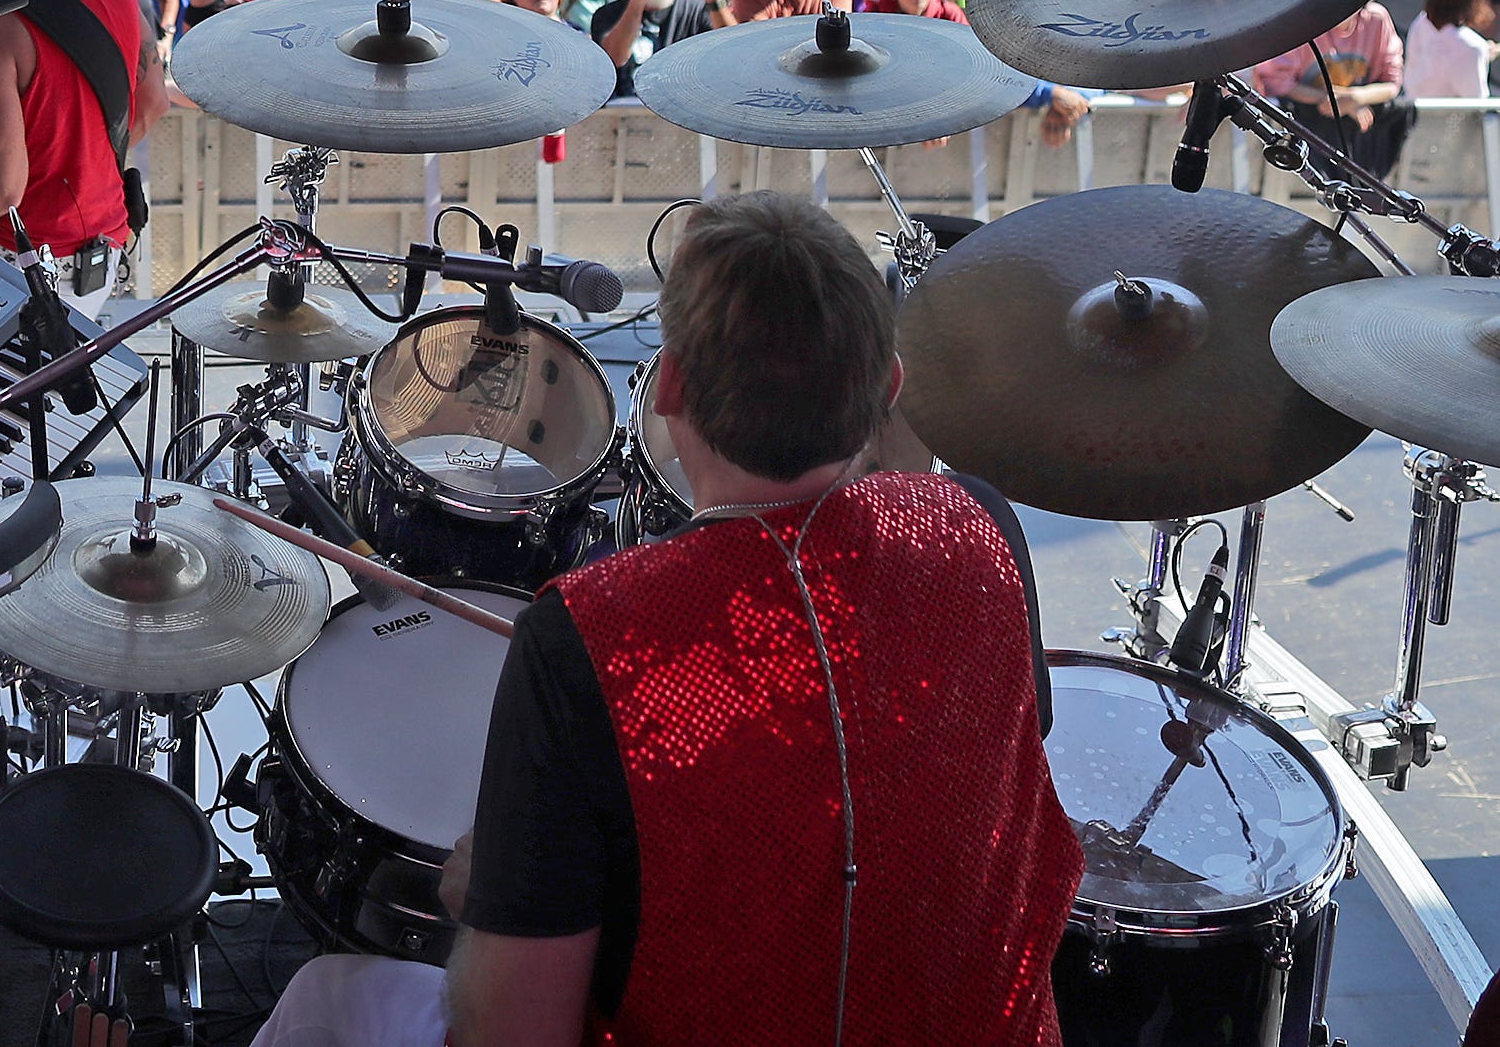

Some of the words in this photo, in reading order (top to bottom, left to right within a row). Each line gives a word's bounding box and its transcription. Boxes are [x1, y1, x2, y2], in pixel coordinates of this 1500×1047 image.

[1032, 12, 1211, 48] Zildjian
[503, 41, 551, 88] Zildjian
[732, 92, 863, 116] Zildjian
[470, 334, 530, 355] EVANS
[371, 610, 432, 637] EVANS
[1272, 751, 1307, 783] EVANS
